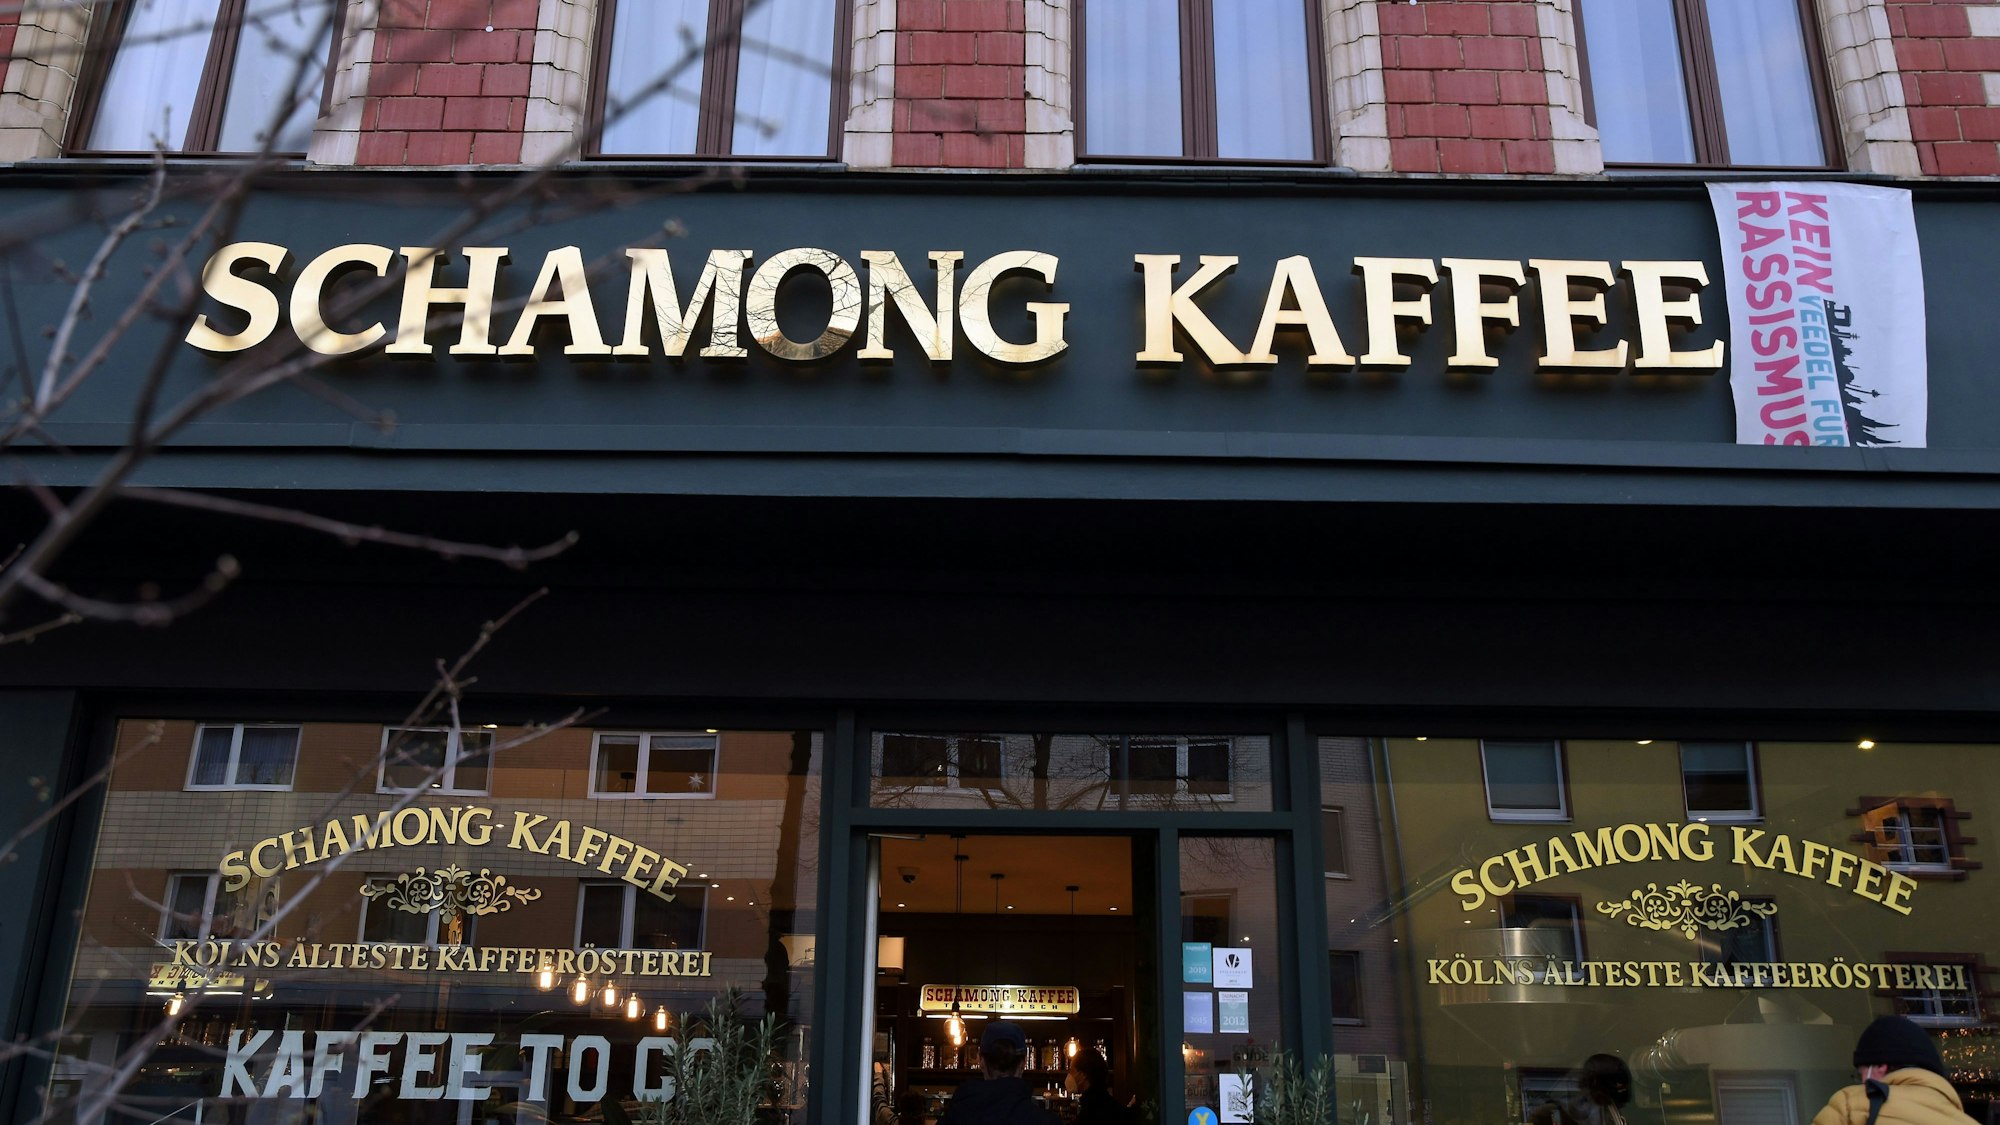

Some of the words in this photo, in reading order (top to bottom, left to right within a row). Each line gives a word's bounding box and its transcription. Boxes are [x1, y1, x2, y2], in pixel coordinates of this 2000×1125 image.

[1785, 192, 1833, 293] KEIN
[185, 242, 1070, 363] SCHAMONG
[1134, 253, 1724, 369] KAFFEE
[1799, 295, 1834, 390] VEEDEL
[220, 807, 494, 893] SCHAMONG
[507, 811, 688, 903] KAFFEE
[1451, 823, 1714, 911] SCHAMONG
[1731, 826, 1918, 916] KAFFEE
[171, 934, 280, 968] KÖLNS
[287, 937, 429, 970] ÄLTESTE
[436, 943, 712, 977] KAFFEERÖSTEREI
[1188, 966, 1207, 975] 2019
[1427, 953, 1534, 985] KÖLNS
[1543, 954, 1684, 987] ÄLTESTE
[1689, 957, 1967, 990] KAFFEERÖSTEREI
[926, 988, 1010, 1002] SCHAMONG
[1018, 989, 1075, 1004] KAFFEE
[1223, 1016, 1246, 1026] 2012
[218, 1029, 496, 1101] KAFFEE
[519, 1033, 612, 1102] TO
